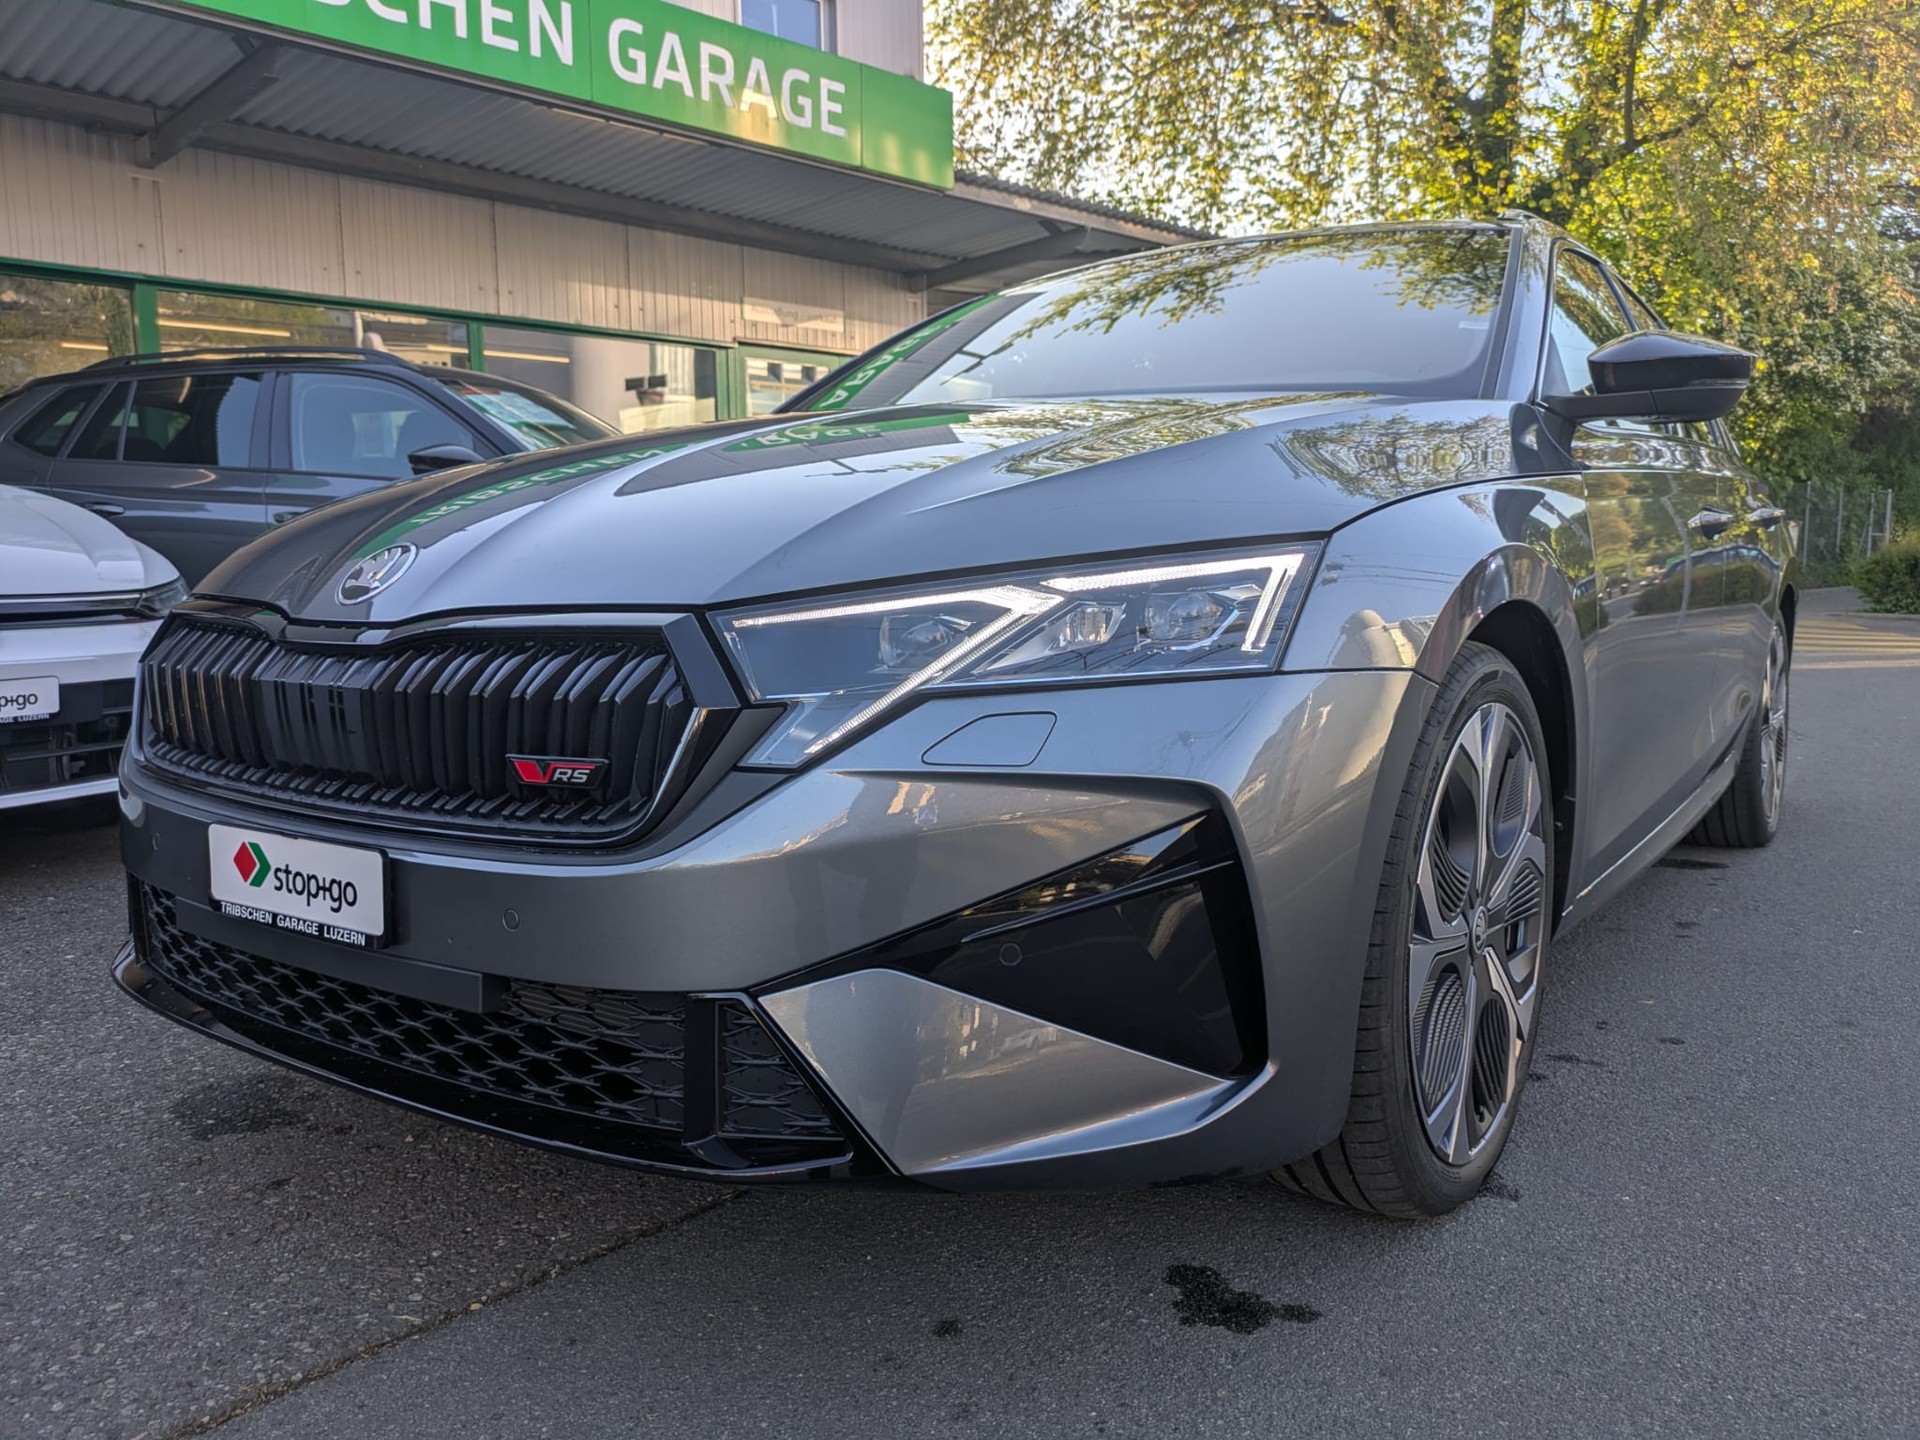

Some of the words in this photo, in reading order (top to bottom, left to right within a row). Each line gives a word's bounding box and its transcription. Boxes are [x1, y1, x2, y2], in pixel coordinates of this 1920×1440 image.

[314, 0, 574, 66] HEN
[608, 17, 847, 137] GARAGE
[274, 864, 358, 913] stop+go
[220, 901, 273, 925] TRIBSCHEN
[277, 914, 319, 935] GARAGE
[324, 925, 366, 946] LUZERN
